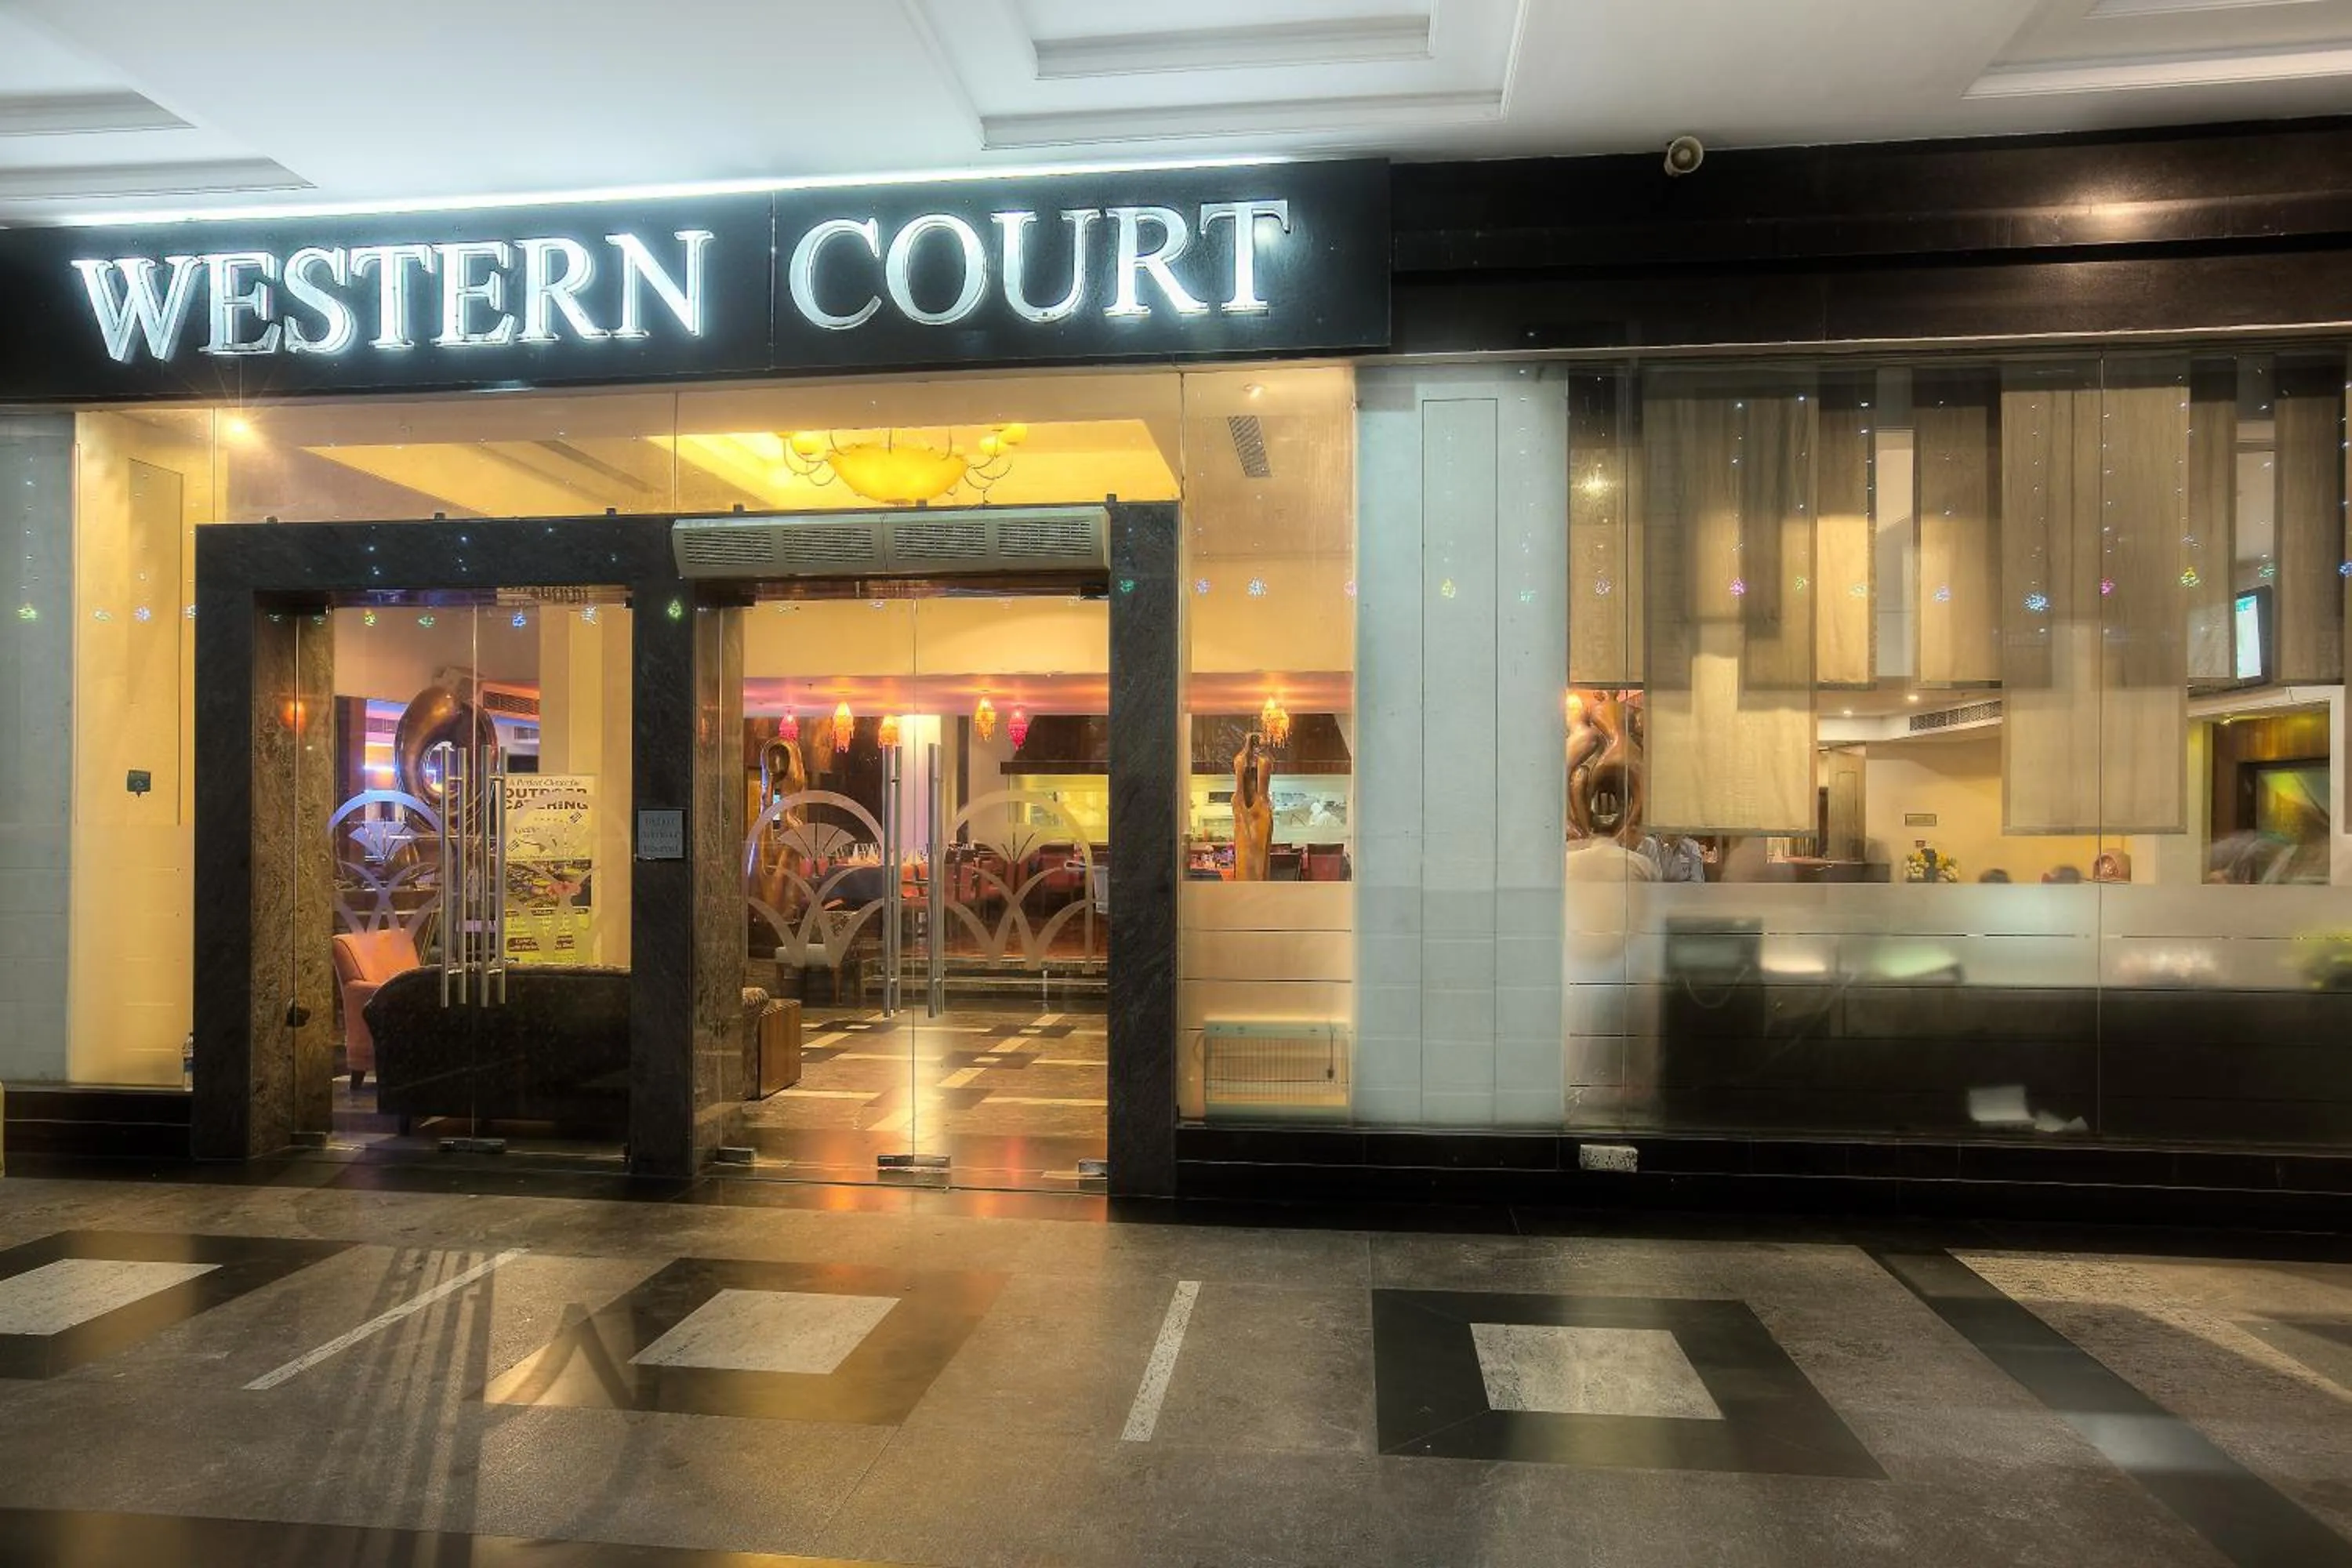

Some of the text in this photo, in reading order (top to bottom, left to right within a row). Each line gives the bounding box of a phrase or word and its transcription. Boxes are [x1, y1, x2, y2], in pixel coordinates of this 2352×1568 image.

[71, 199, 1290, 363] WESTERN COURT
[506, 788, 586, 798] OUTDR
[506, 800, 588, 809] CARING
